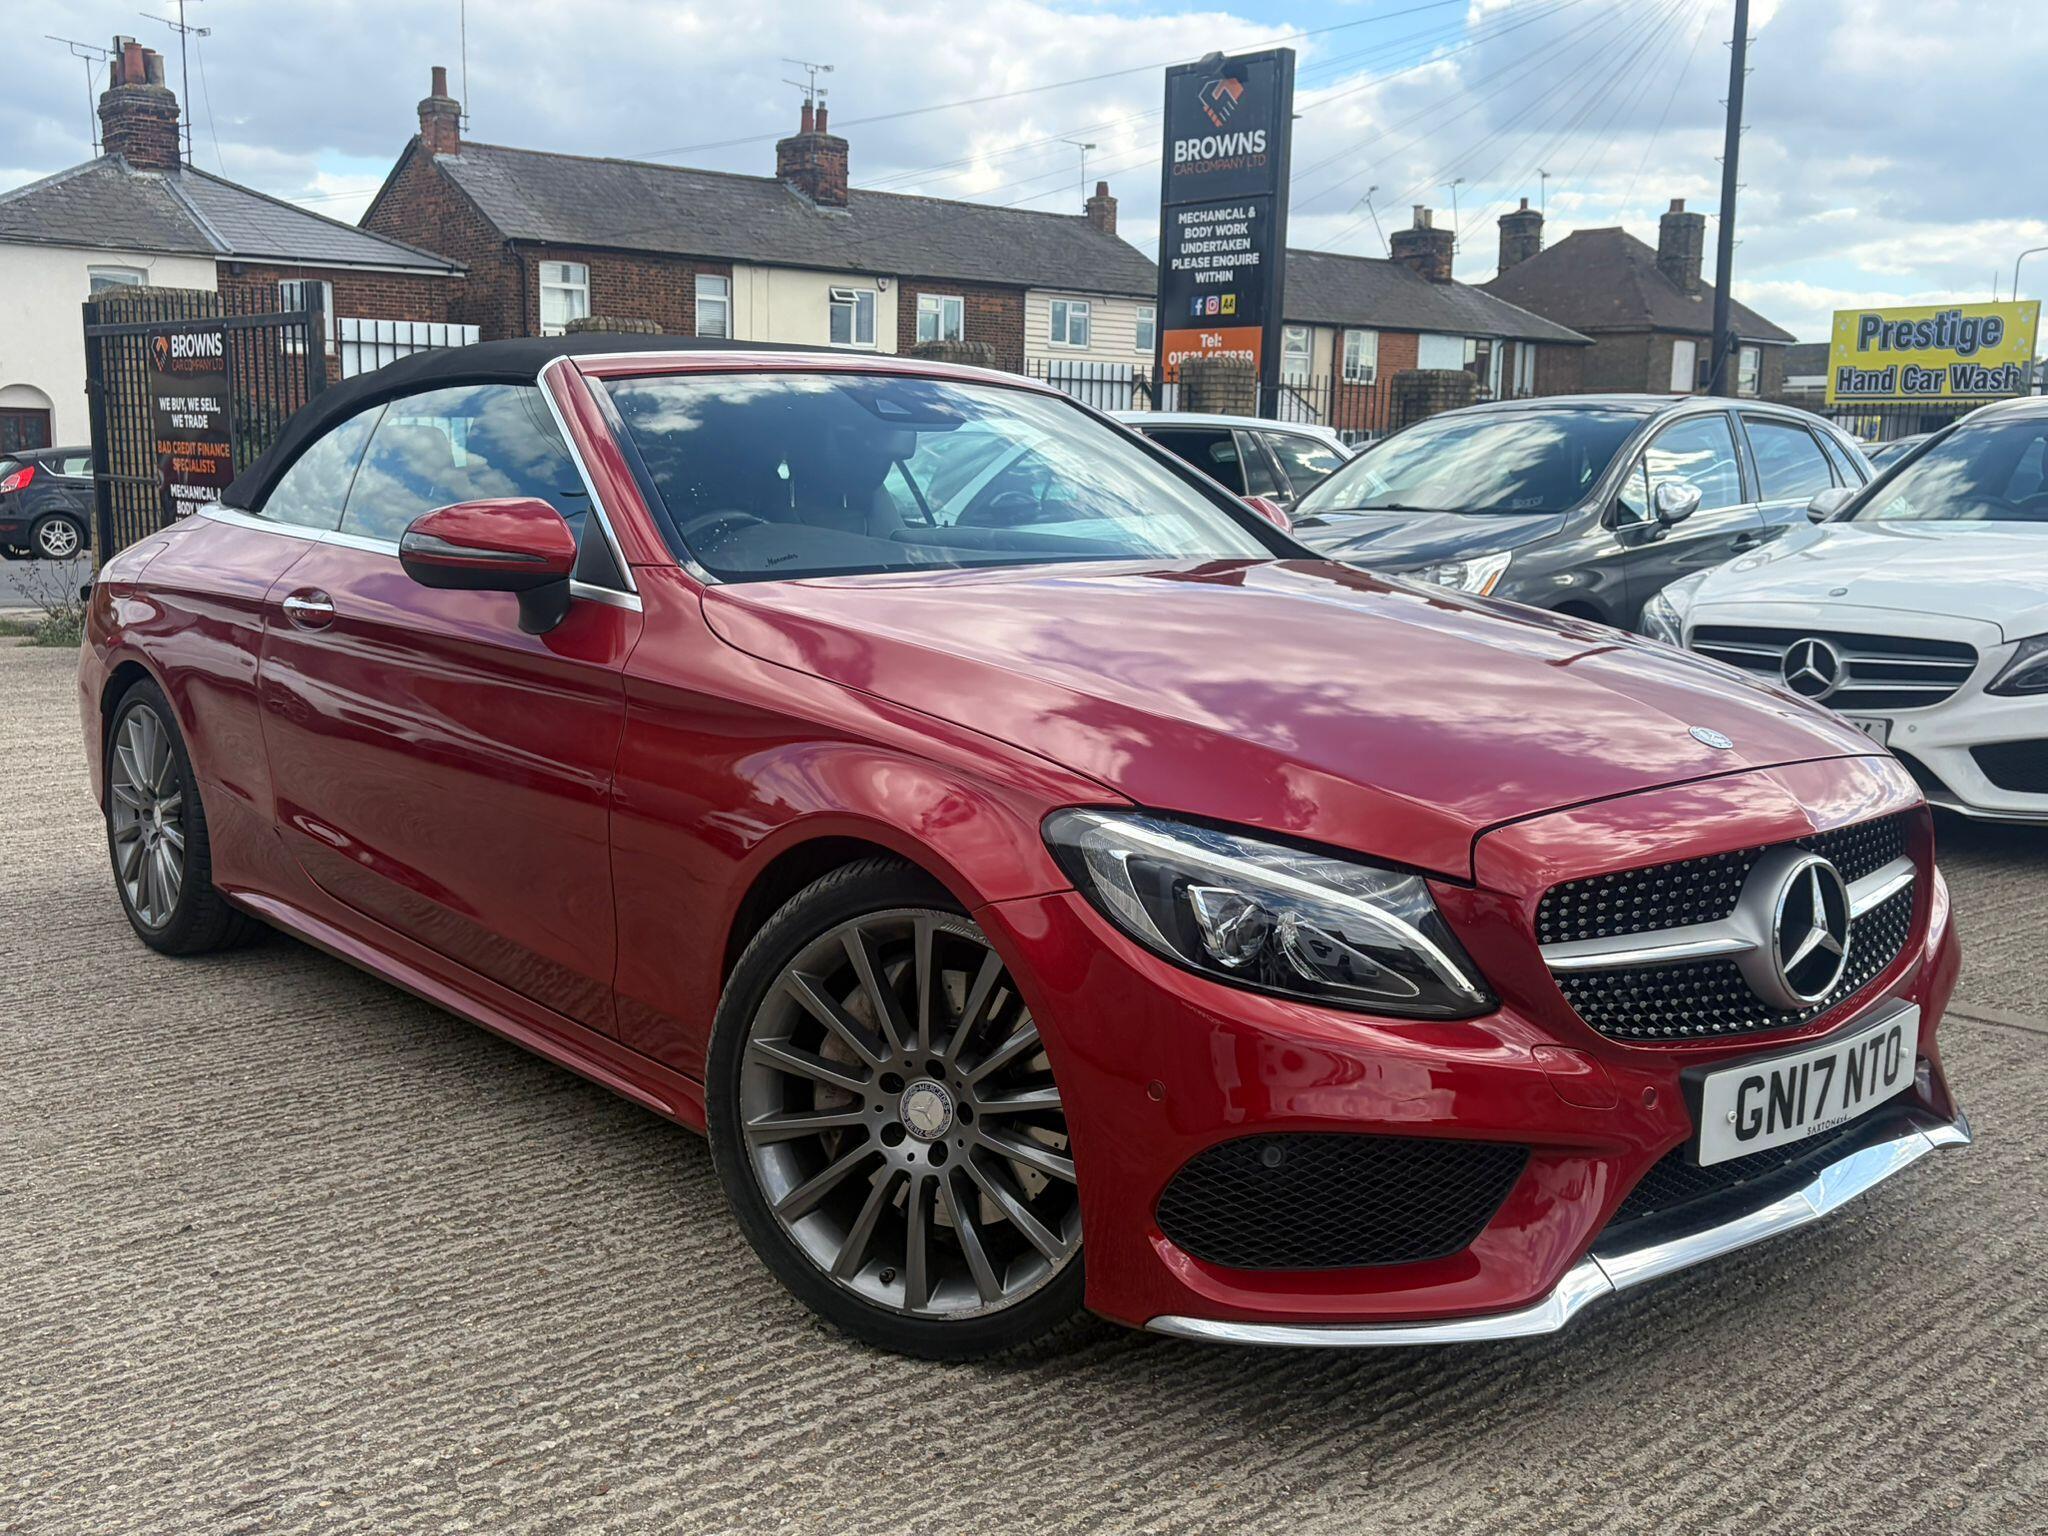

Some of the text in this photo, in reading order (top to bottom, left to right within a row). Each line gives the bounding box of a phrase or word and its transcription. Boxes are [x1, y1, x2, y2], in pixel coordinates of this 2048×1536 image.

[1174, 129, 1266, 163] BROWNS
[1173, 154, 1266, 176] CAR COMPANY LTD
[1178, 206, 1256, 225] MECHANICAL &
[1184, 223, 1249, 239] BODY WORK
[1181, 238, 1250, 254] UNDERTAKEN
[1172, 252, 1260, 270] PLEASE ENQUIRE
[1195, 270, 1233, 284] WITHIN
[1200, 333, 1222, 348] Tel:
[1857, 309, 2004, 357] Prestige
[171, 332, 223, 358] BROWNS
[1835, 361, 2022, 394] Hand Car Wash
[158, 397, 221, 414] WE BUY, WE SELL,
[171, 414, 209, 429] WE TRADE
[158, 440, 230, 457] BAD CREDIT FINANCE
[172, 457, 216, 474] SPECIALISTS
[170, 483, 217, 501] MECHANICAL
[176, 500, 195, 515] BODY
[1735, 1024, 1903, 1142] GN17 NTO
